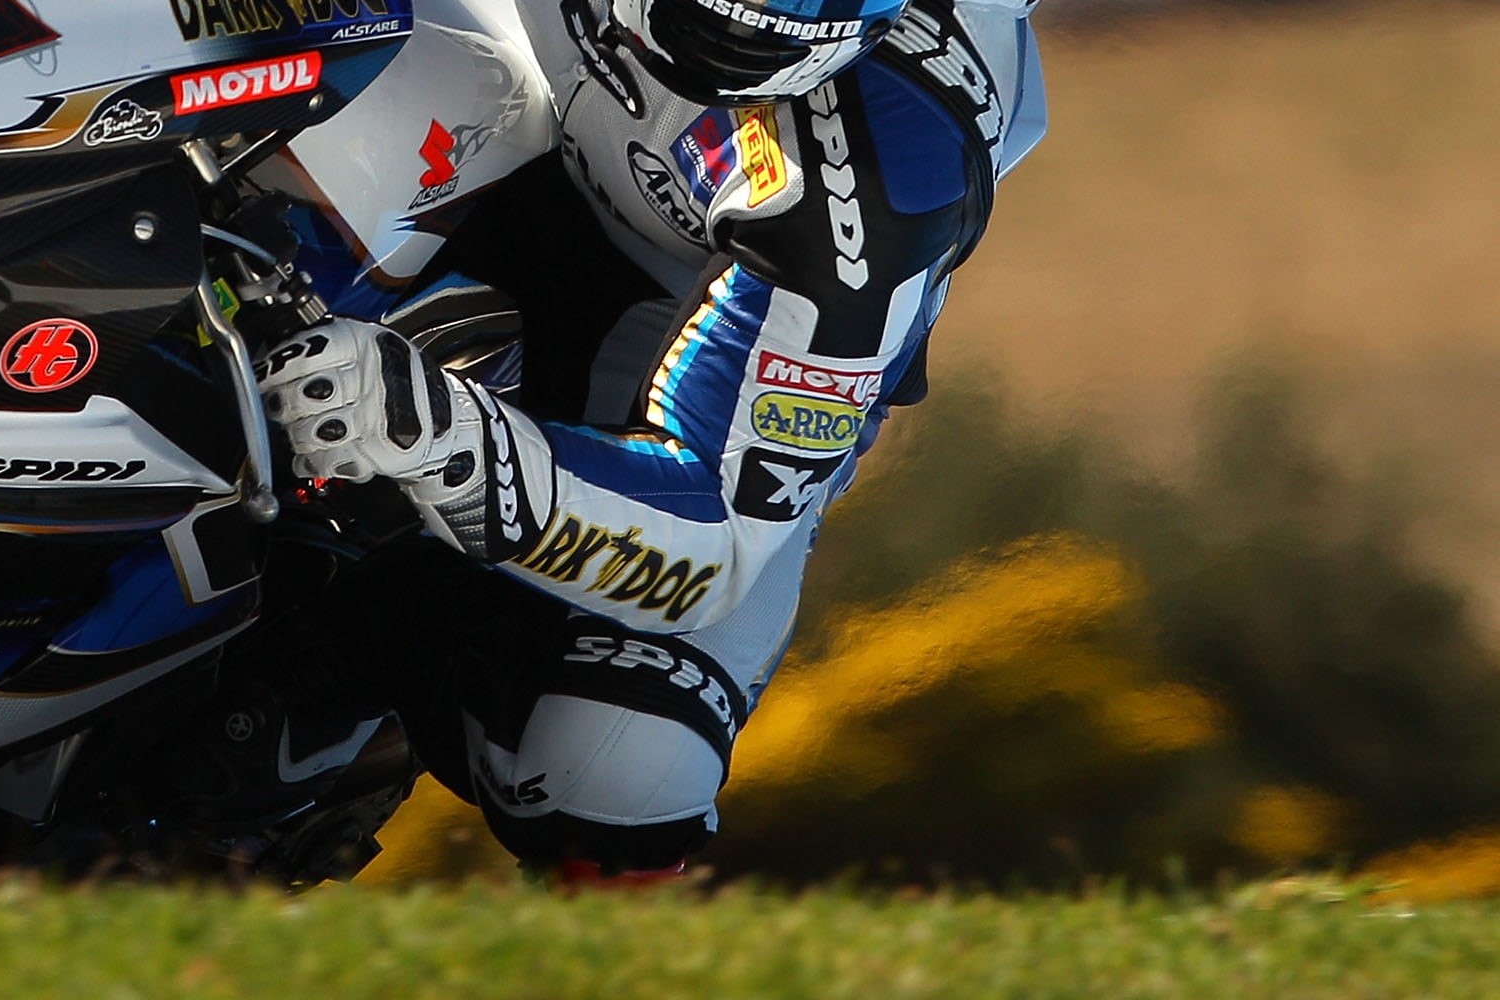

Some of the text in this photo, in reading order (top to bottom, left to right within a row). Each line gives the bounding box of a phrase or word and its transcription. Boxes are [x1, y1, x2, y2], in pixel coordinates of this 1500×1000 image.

[331, 19, 399, 40] ALSTARE
[181, 59, 314, 109] MOTUL
[683, 132, 719, 194] SUPERBIKE
[806, 79, 869, 291] SPIDI
[756, 403, 863, 441] ARRO
[603, 546, 722, 623] DOG
